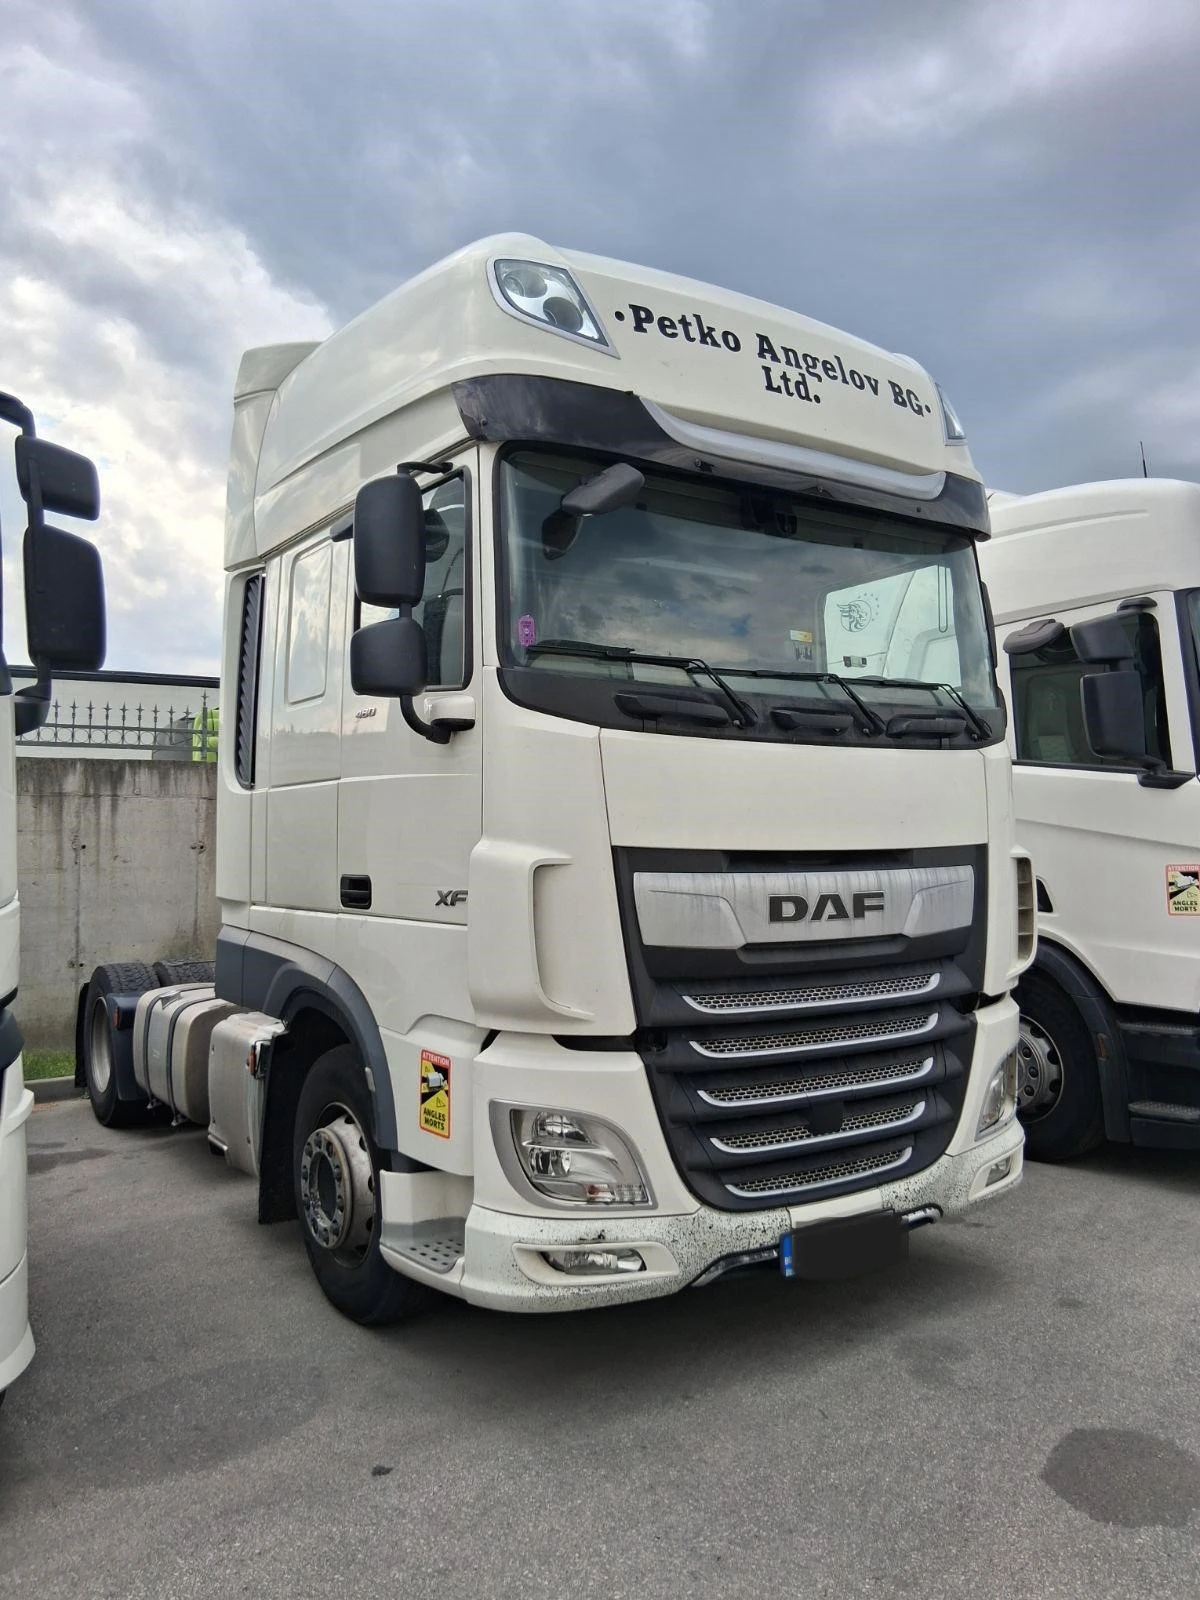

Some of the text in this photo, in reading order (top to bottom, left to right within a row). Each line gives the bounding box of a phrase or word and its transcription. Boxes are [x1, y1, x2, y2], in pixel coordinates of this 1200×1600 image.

[755, 333, 880, 396] Angelov
[761, 365, 822, 404] Ltd.
[435, 889, 469, 907] XF
[769, 891, 885, 923] DAF
[422, 1052, 449, 1065] ATTENTION
[423, 1107, 446, 1121] ANGLES
[424, 1116, 445, 1131] MORTS
